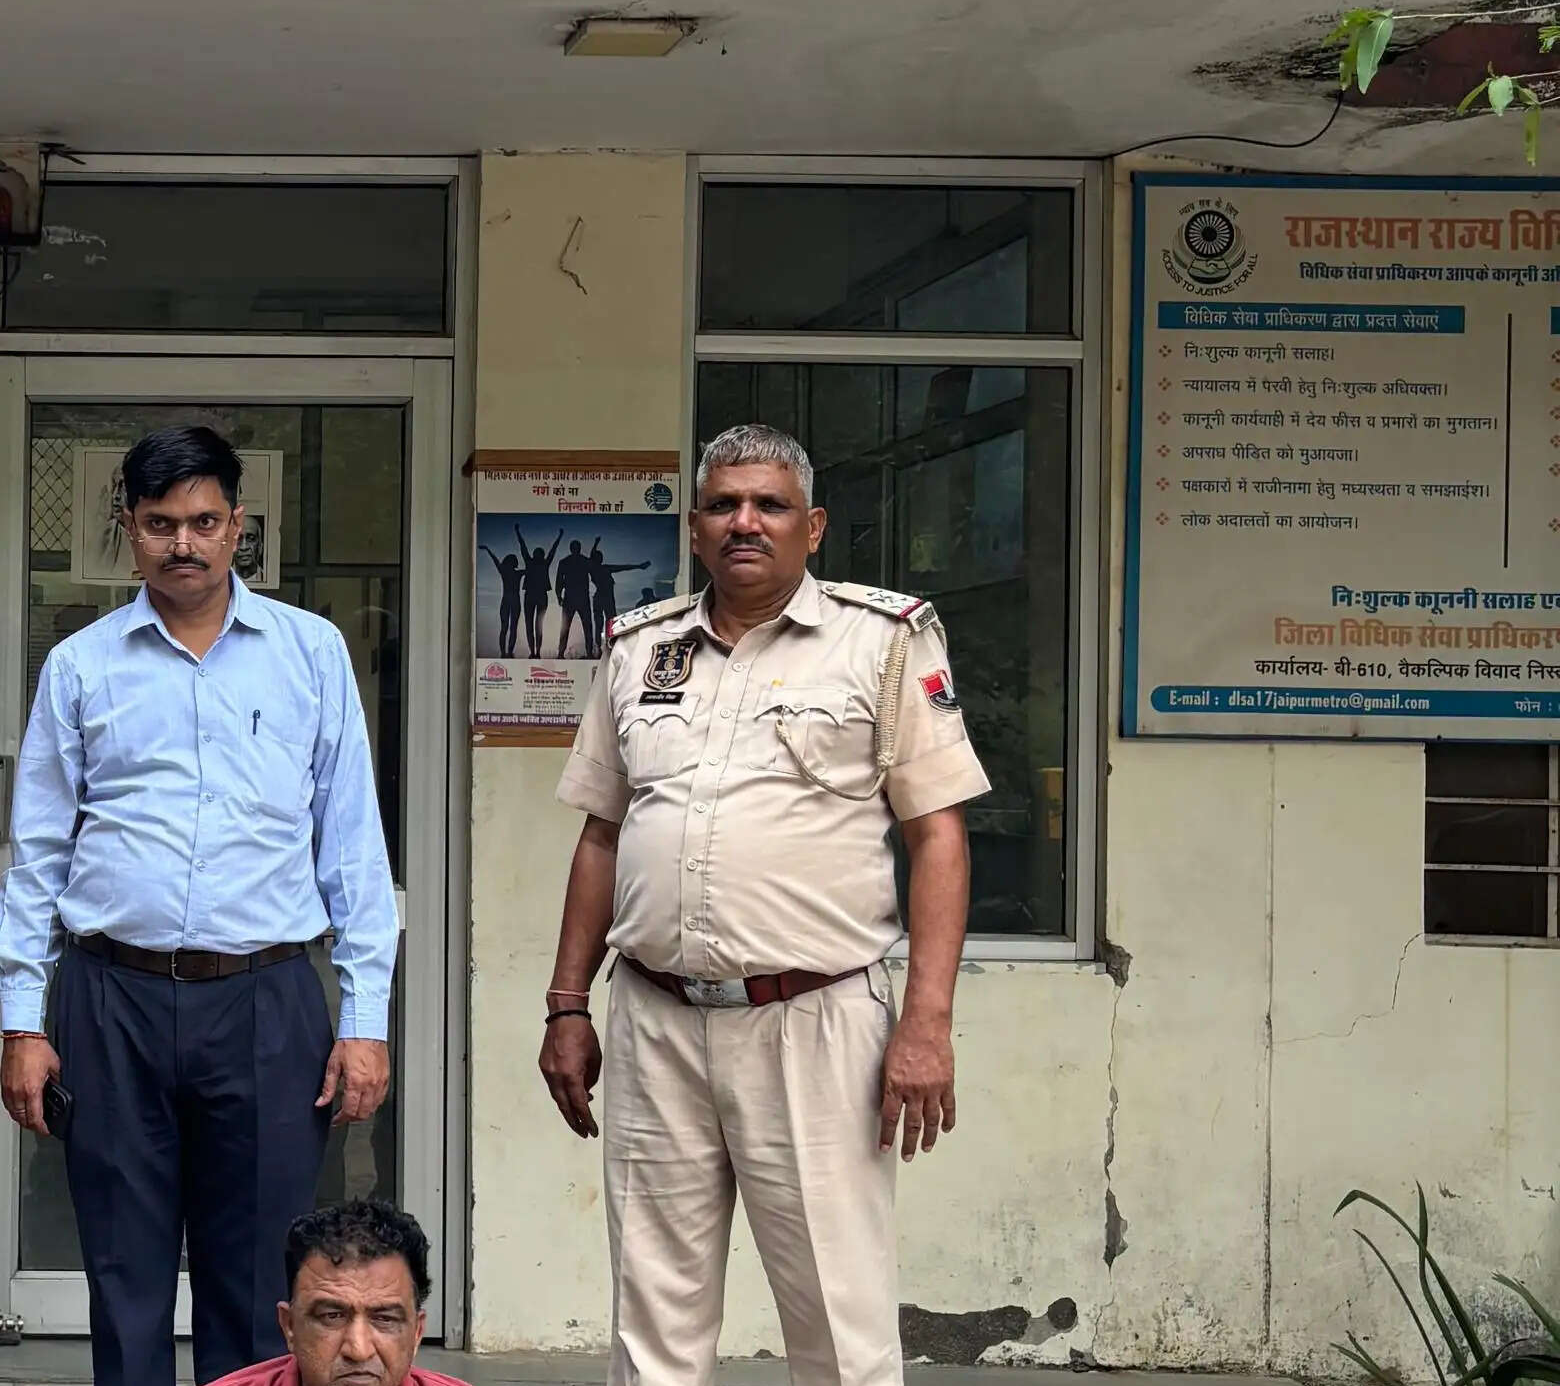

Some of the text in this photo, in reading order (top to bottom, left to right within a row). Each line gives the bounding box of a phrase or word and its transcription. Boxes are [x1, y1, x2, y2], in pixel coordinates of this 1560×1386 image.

[1284, 216, 1422, 250] राजस्थान
[1426, 217, 1503, 251] राज्य
[1182, 281, 1195, 293] TO
[1234, 270, 1249, 287] FOR
[1246, 254, 1258, 275] ALL
[1299, 261, 1344, 281] विधिक
[1345, 261, 1373, 281] सेवा
[1375, 263, 1443, 282] प्राधिकरण
[1445, 264, 1489, 282] आपके
[1491, 265, 1540, 287] कानूनी
[1184, 305, 1227, 326] विधिक
[1232, 305, 1259, 326] सेवा
[1264, 307, 1327, 328] प्राधिकरण
[1332, 313, 1360, 329] द्वारा
[1365, 314, 1397, 329] प्रदत्त
[1244, 342, 1286, 364] कानूनी
[1182, 379, 1240, 394] न्यायालय
[1245, 375, 1256, 394] में
[1262, 374, 1292, 394] पैरवी
[1298, 376, 1317, 399] हेतु
[1182, 408, 1226, 430] कानूनी
[1230, 409, 1285, 428] कार्यवाही
[1290, 411, 1301, 428] में
[1305, 410, 1327, 428] देय
[1331, 410, 1361, 429] फीस
[1366, 415, 1376, 428] व
[1423, 417, 1440, 429] का
[1182, 445, 1225, 460] अपराध
[1275, 442, 1294, 460] को
[532, 481, 579, 497] नशे को ना
[1181, 477, 1231, 493] पक्षकारों
[1236, 477, 1248, 493] में
[1251, 476, 1312, 494] राजीनामा
[1316, 477, 1336, 500] हेतु
[1341, 483, 1402, 497] मध्यस्थता
[1405, 485, 1416, 497] व
[599, 501, 611, 513] को
[1180, 509, 1212, 527] लोक
[1216, 511, 1271, 528] अदालतों
[1275, 515, 1292, 528] का
[1481, 592, 1538, 611] सलाह
[1274, 616, 1560, 649] जिला विधिक सेवा प्राधिकर
[1398, 657, 1470, 678] वैकल्पिक
[1474, 658, 1522, 679] विवाद
[1169, 689, 1210, 707] E-mail
[1514, 697, 1541, 714] फोन
